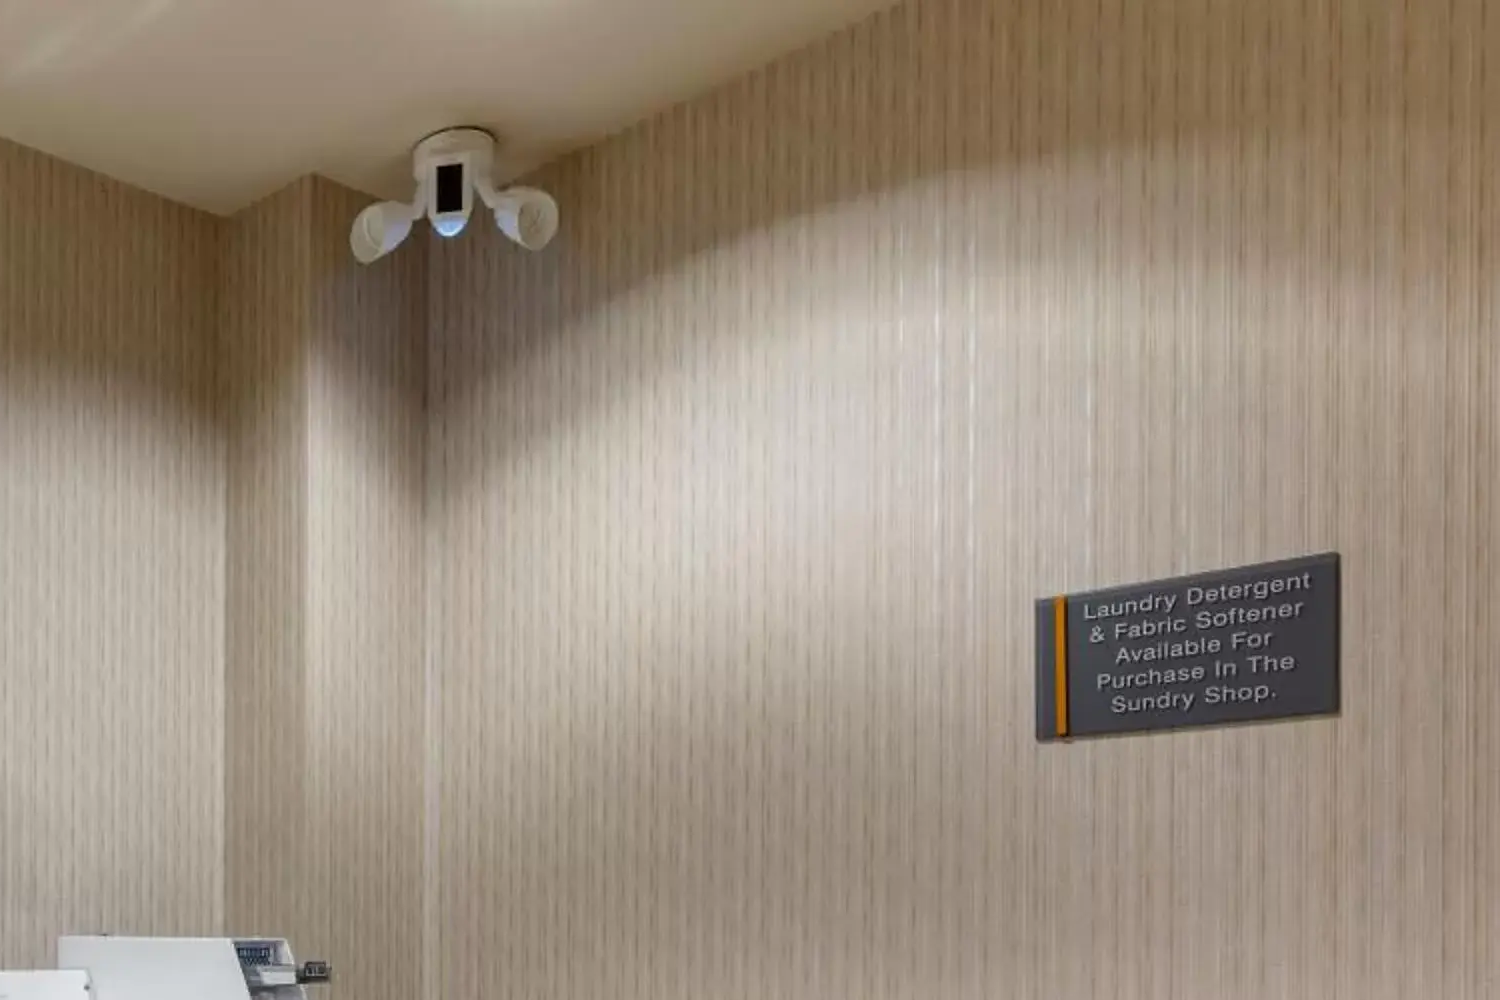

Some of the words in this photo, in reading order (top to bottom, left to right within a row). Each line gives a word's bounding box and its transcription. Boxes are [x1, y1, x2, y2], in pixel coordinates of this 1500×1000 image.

[1083, 593, 1177, 620] Laundry
[1187, 572, 1311, 605] Detergent
[1089, 625, 1105, 643] &
[1115, 616, 1187, 639] Fabric
[1195, 601, 1304, 629] Softener
[1115, 638, 1221, 664] Available
[1232, 631, 1273, 649] For
[1097, 665, 1205, 690] Purchase
[1215, 661, 1237, 676] In
[1246, 655, 1296, 673] The
[1111, 692, 1194, 713] Sundry
[1204, 683, 1277, 704] Shop.
